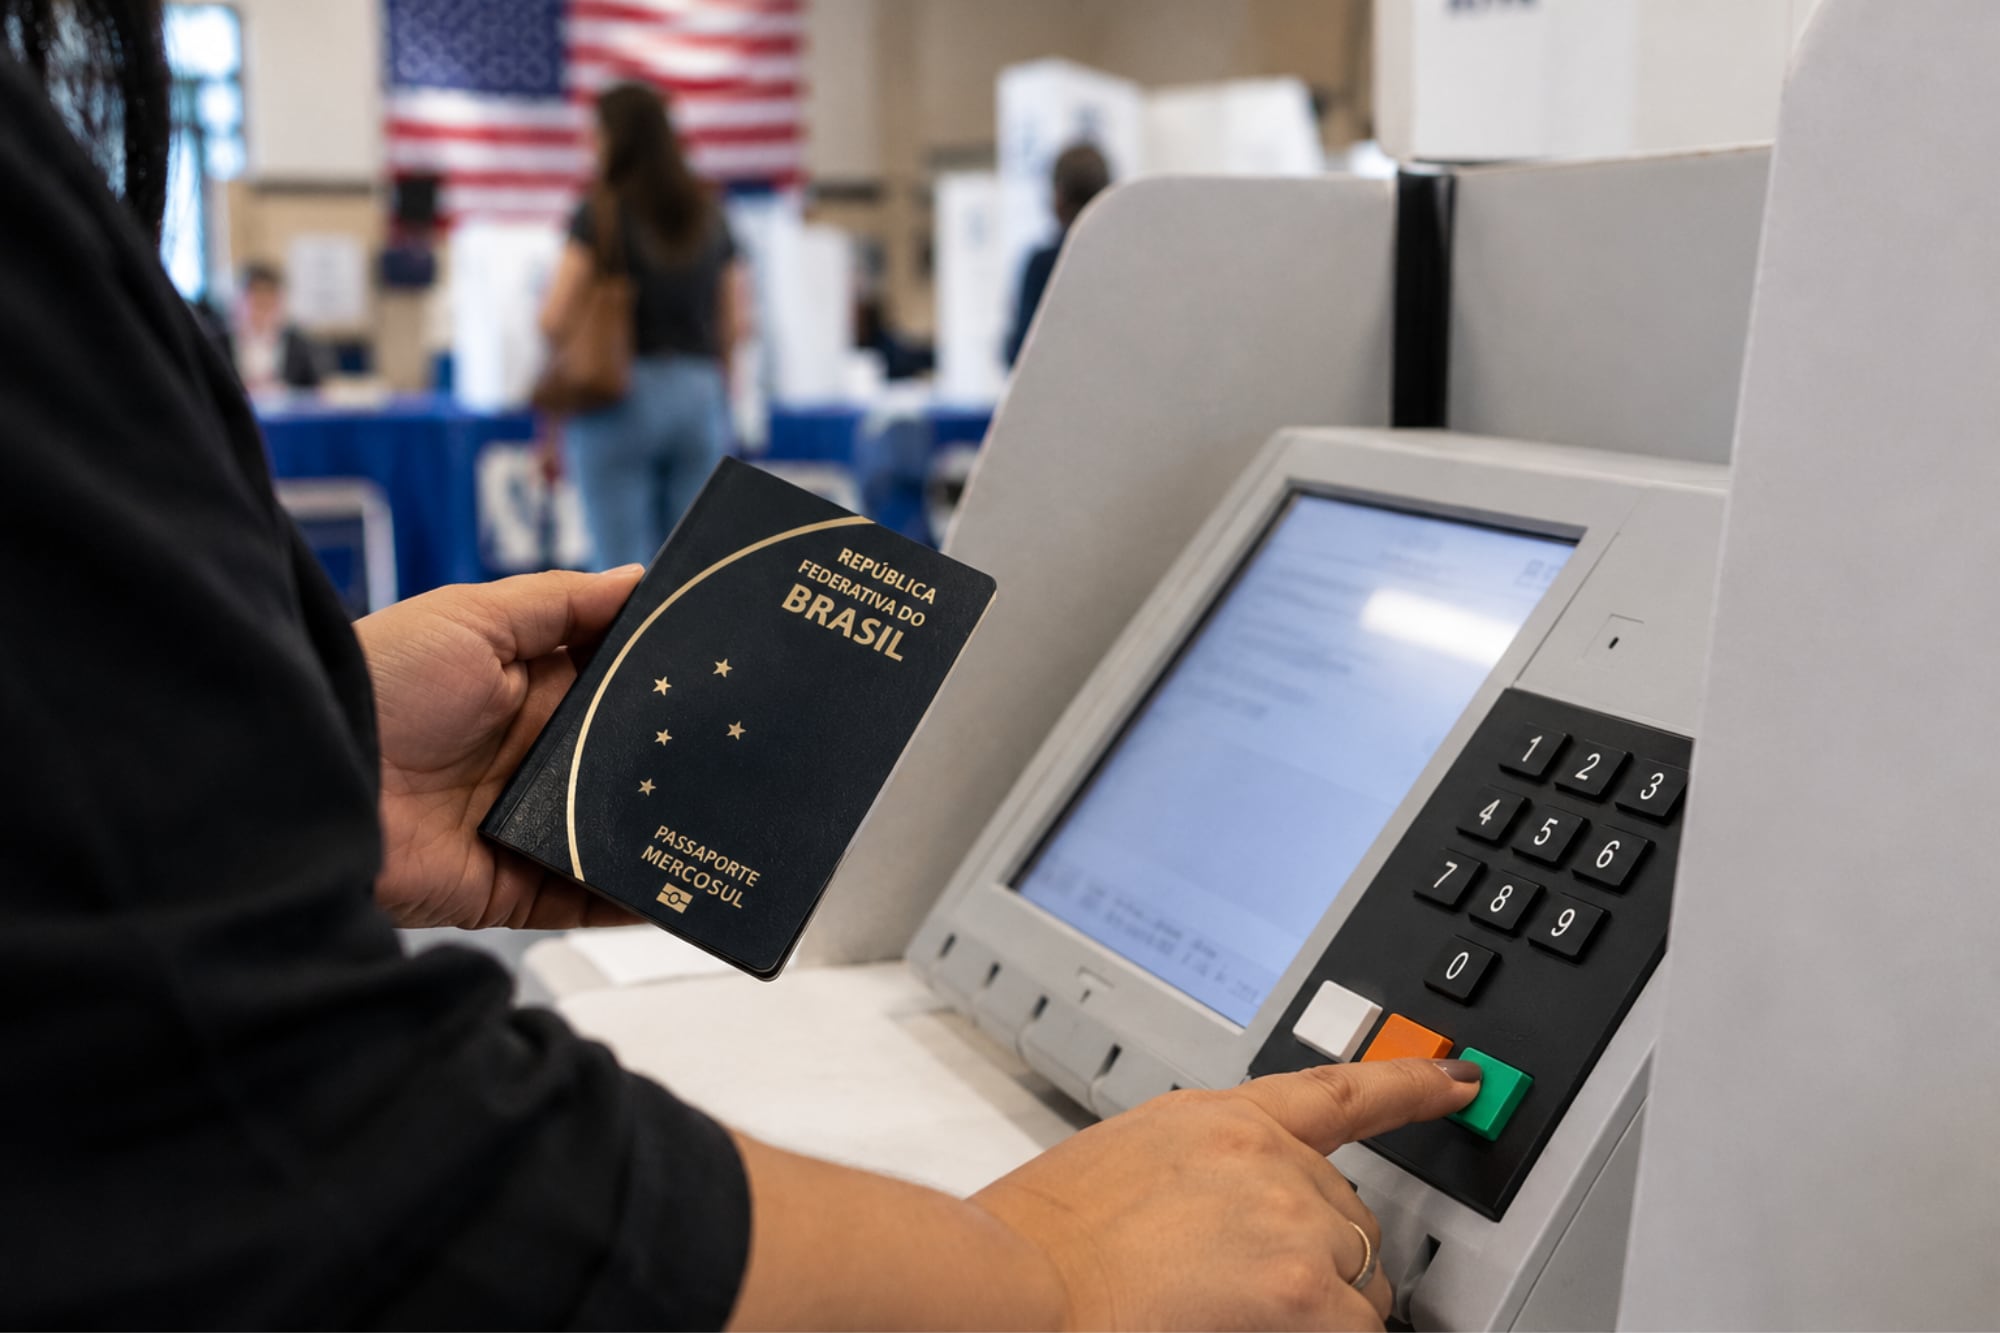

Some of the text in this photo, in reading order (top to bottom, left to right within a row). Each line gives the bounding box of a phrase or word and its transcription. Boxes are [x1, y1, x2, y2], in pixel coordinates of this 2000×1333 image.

[837, 547, 937, 605] REPÚBLICA
[797, 559, 926, 627] FEDERATIVA DO
[781, 583, 904, 662] BRASIL
[1522, 735, 1543, 762] 1
[1574, 752, 1601, 781] 2
[1640, 772, 1665, 800] 3
[1479, 799, 1501, 826] 4
[1533, 817, 1559, 846] 5
[654, 825, 761, 887] PASSAPORTE
[1595, 840, 1621, 869] 6
[641, 845, 743, 909] MERCOSUL
[1433, 861, 1458, 888] 7
[1490, 884, 1514, 913] 8
[1550, 908, 1576, 937] 9
[1445, 951, 1469, 980] 0
